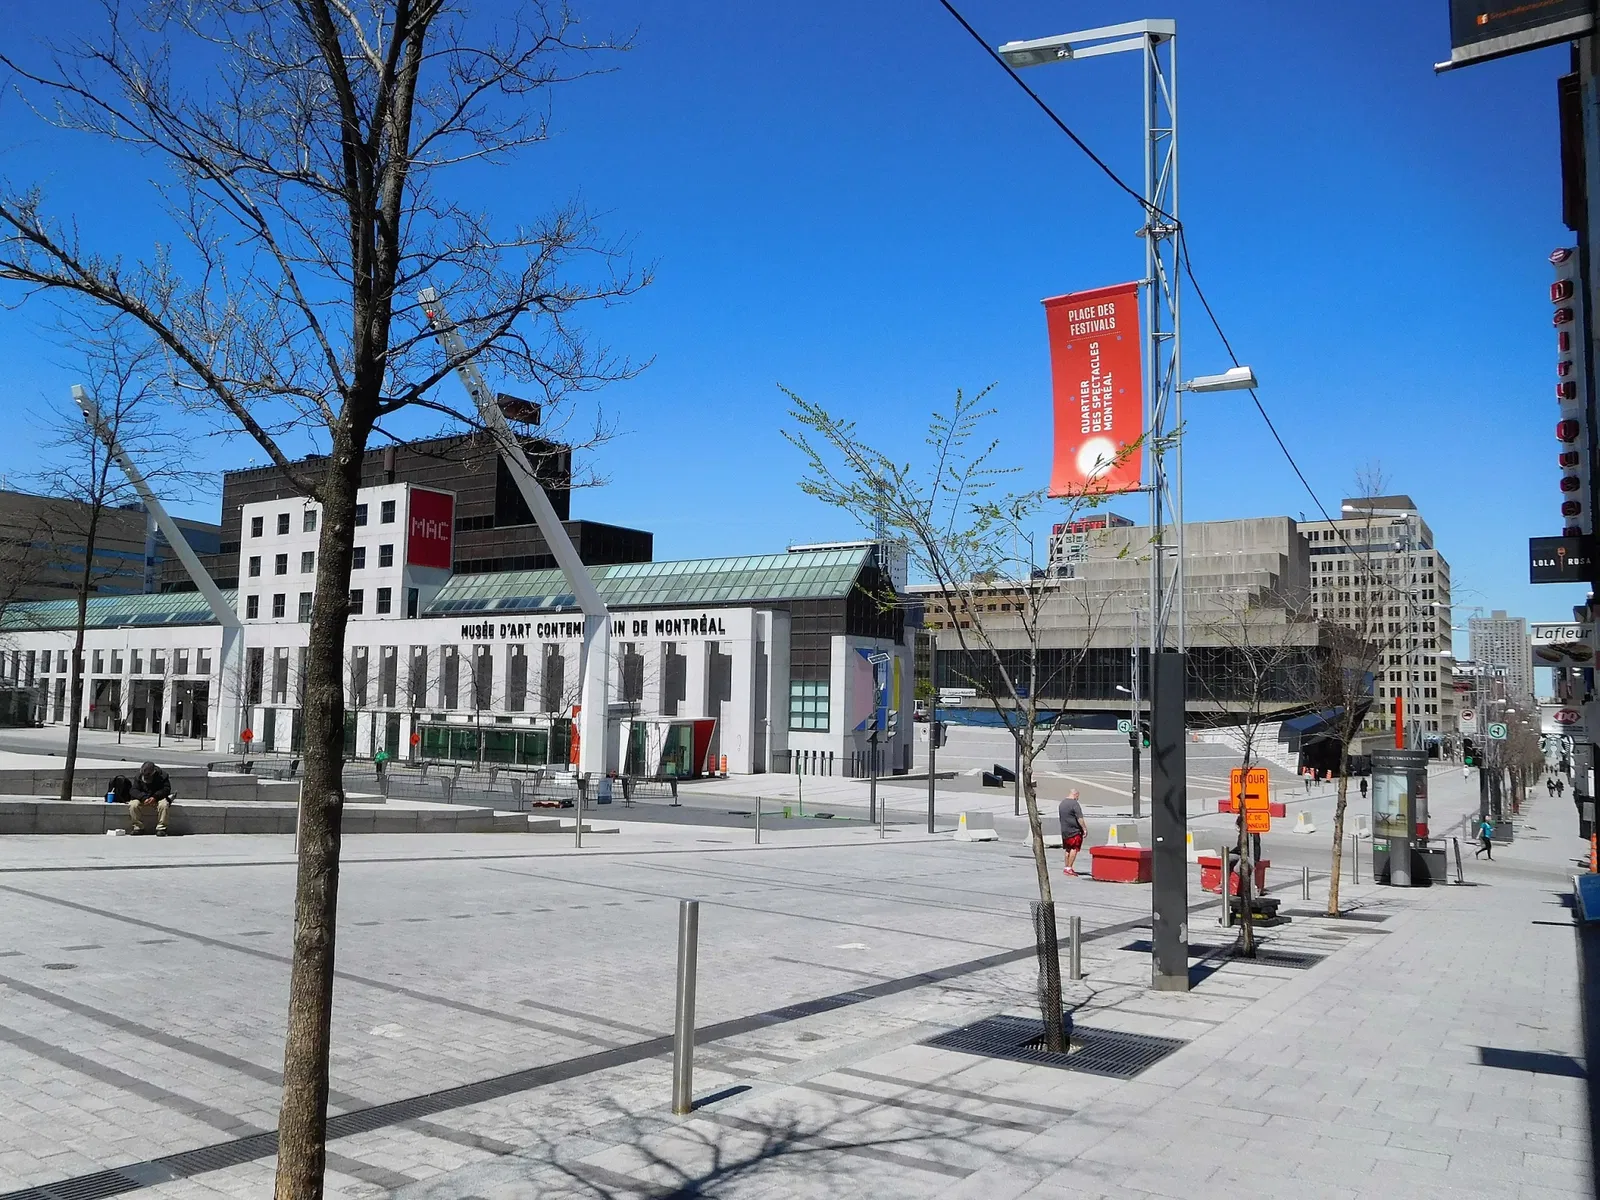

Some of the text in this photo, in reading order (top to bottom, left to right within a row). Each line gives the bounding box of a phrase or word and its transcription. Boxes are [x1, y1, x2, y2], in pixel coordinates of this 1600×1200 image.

[1068, 303, 1115, 322] PLACE DES
[1070, 317, 1116, 336] FESTIVALS
[1090, 341, 1102, 432] DES SPECTACLES
[1080, 380, 1091, 434] QUARTIER
[1100, 372, 1113, 431] MONTRÉAL
[412, 516, 449, 541] MAC
[1533, 557, 1591, 567] LOLA ROSA
[461, 613, 726, 640] MUSÉE D'ART CONTEMIN DE MONTRÉAL
[1535, 627, 1592, 641] Lafleur
[1557, 712, 1578, 722] DQ
[1234, 774, 1265, 784] DOUR
